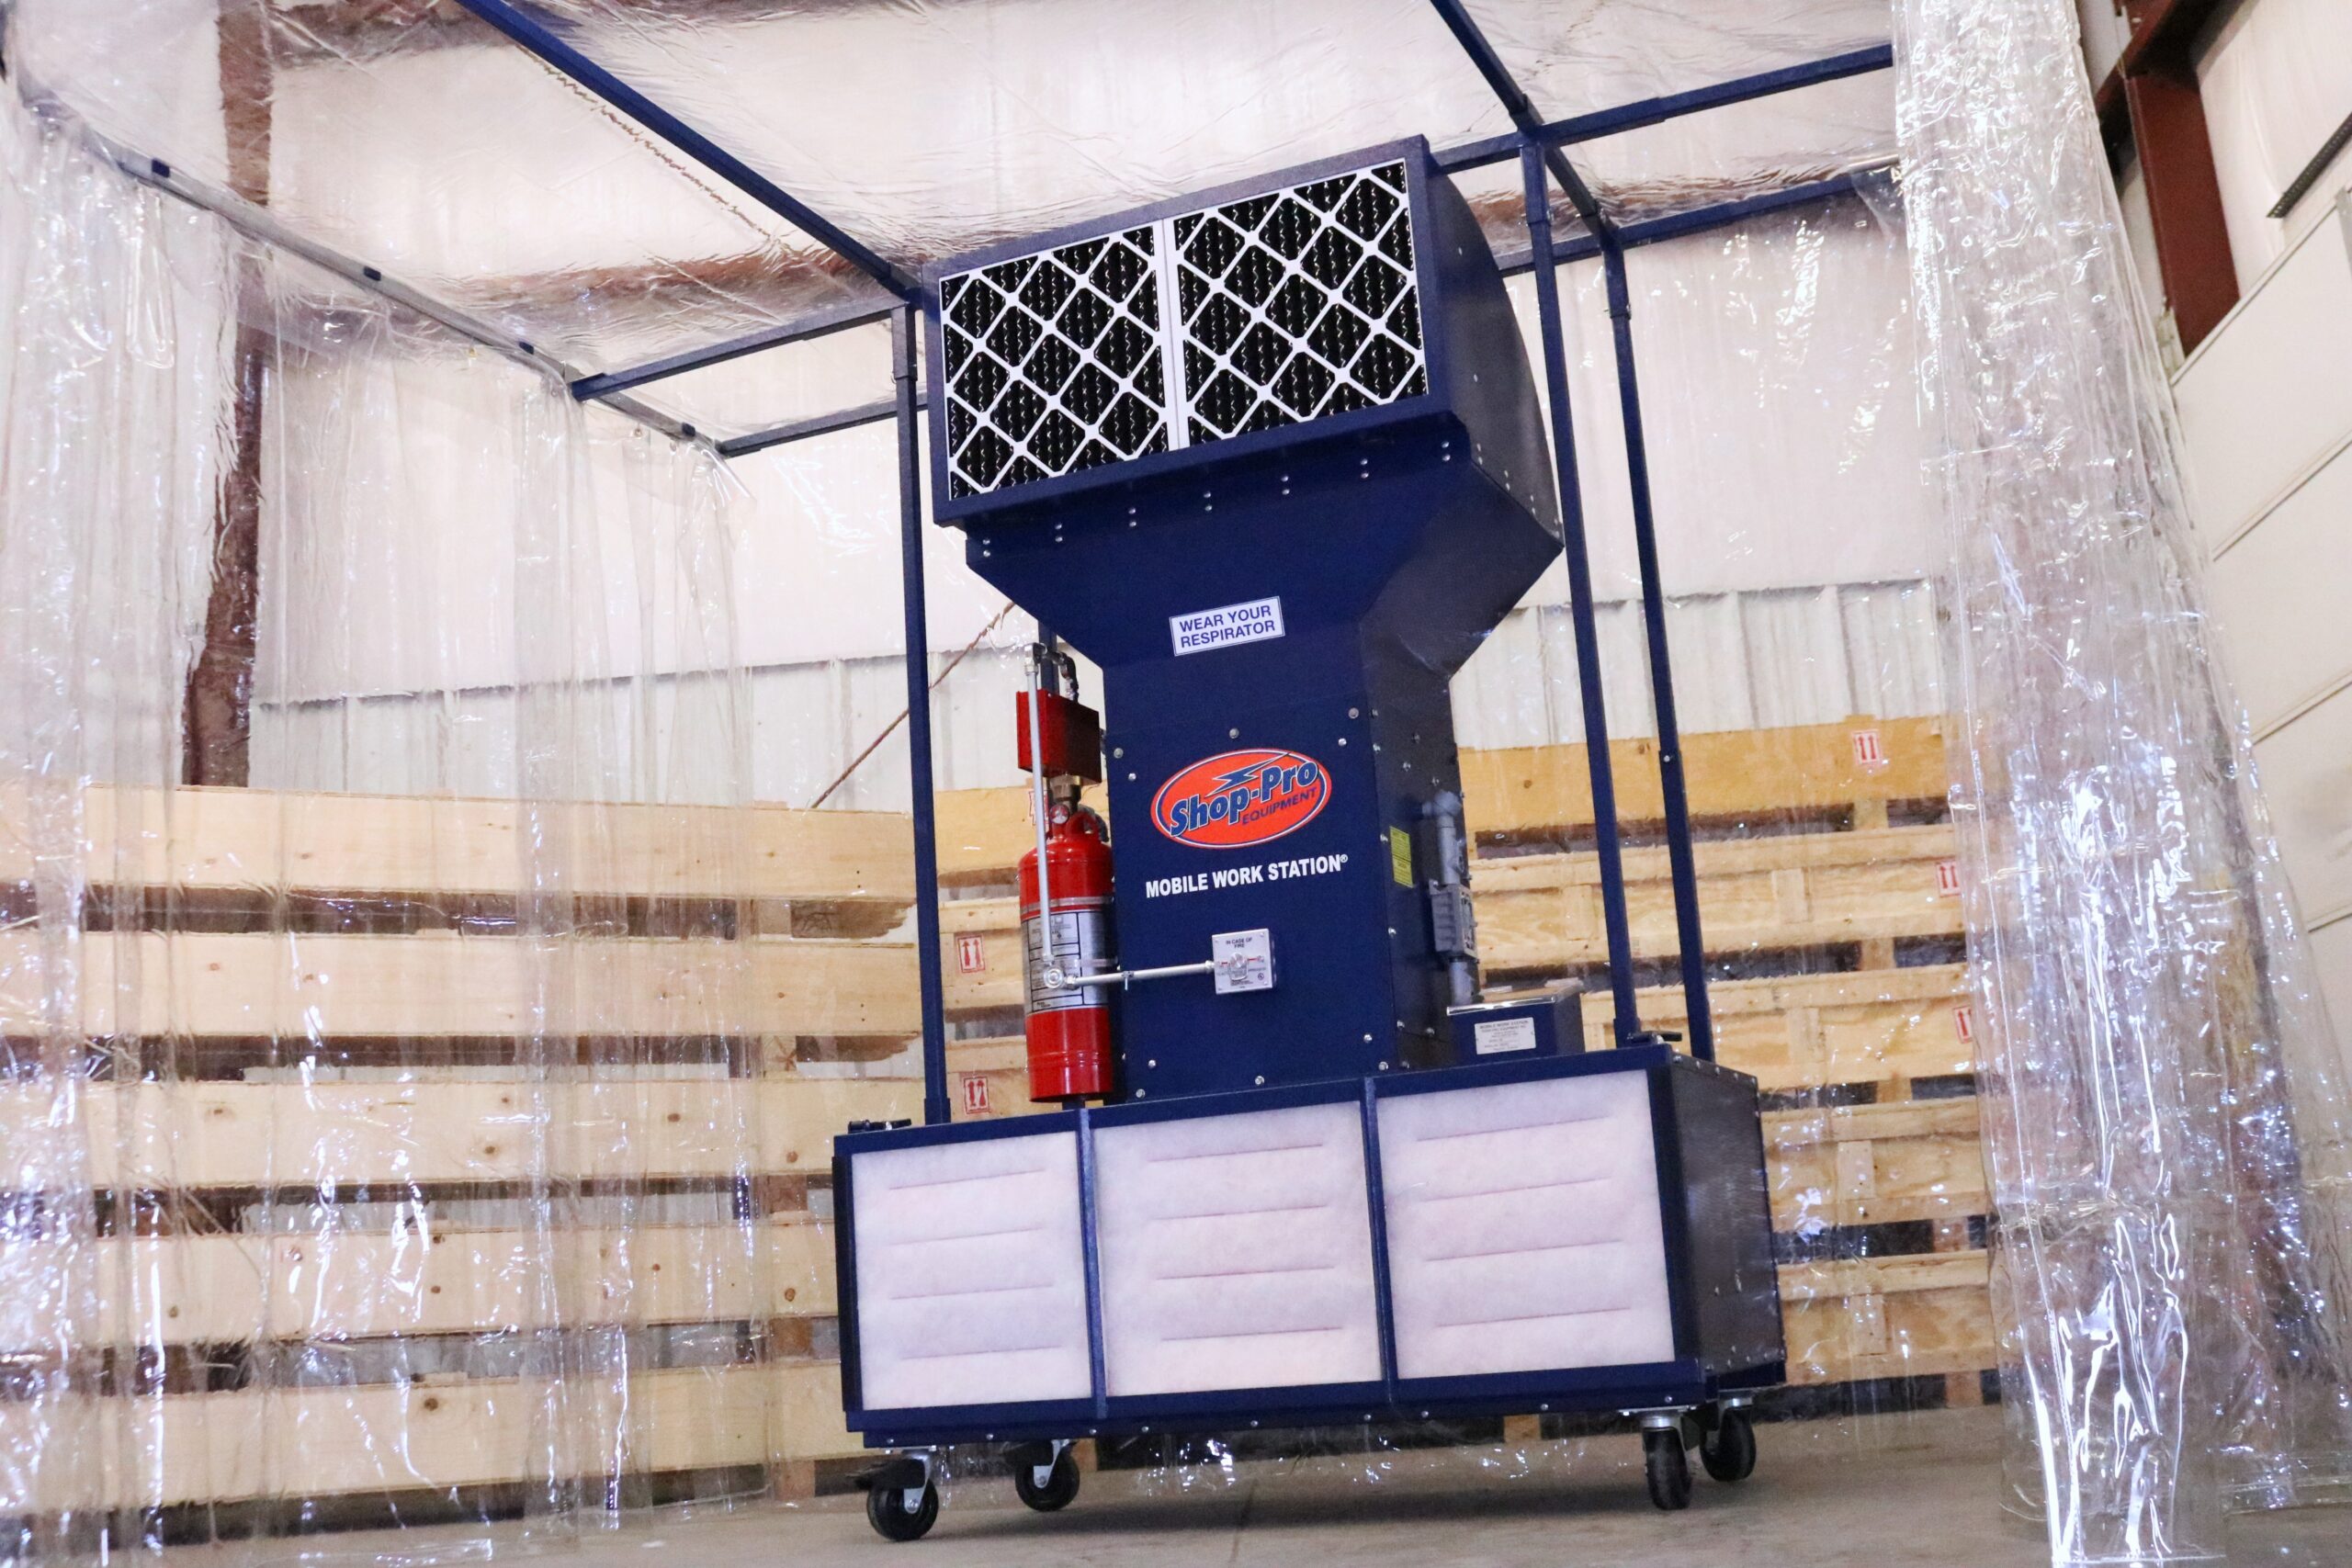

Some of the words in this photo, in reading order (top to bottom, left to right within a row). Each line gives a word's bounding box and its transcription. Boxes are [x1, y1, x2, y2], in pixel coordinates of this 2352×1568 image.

[1180, 614, 1224, 633] WEAR
[1227, 604, 1272, 624] YOUR
[1181, 620, 1275, 649] RESPIRATOR
[1170, 761, 1318, 838] Shop-Pro
[1241, 787, 1317, 826] EQUIPMENT
[1146, 874, 1208, 898] MOBILE
[1212, 864, 1263, 888] WORK
